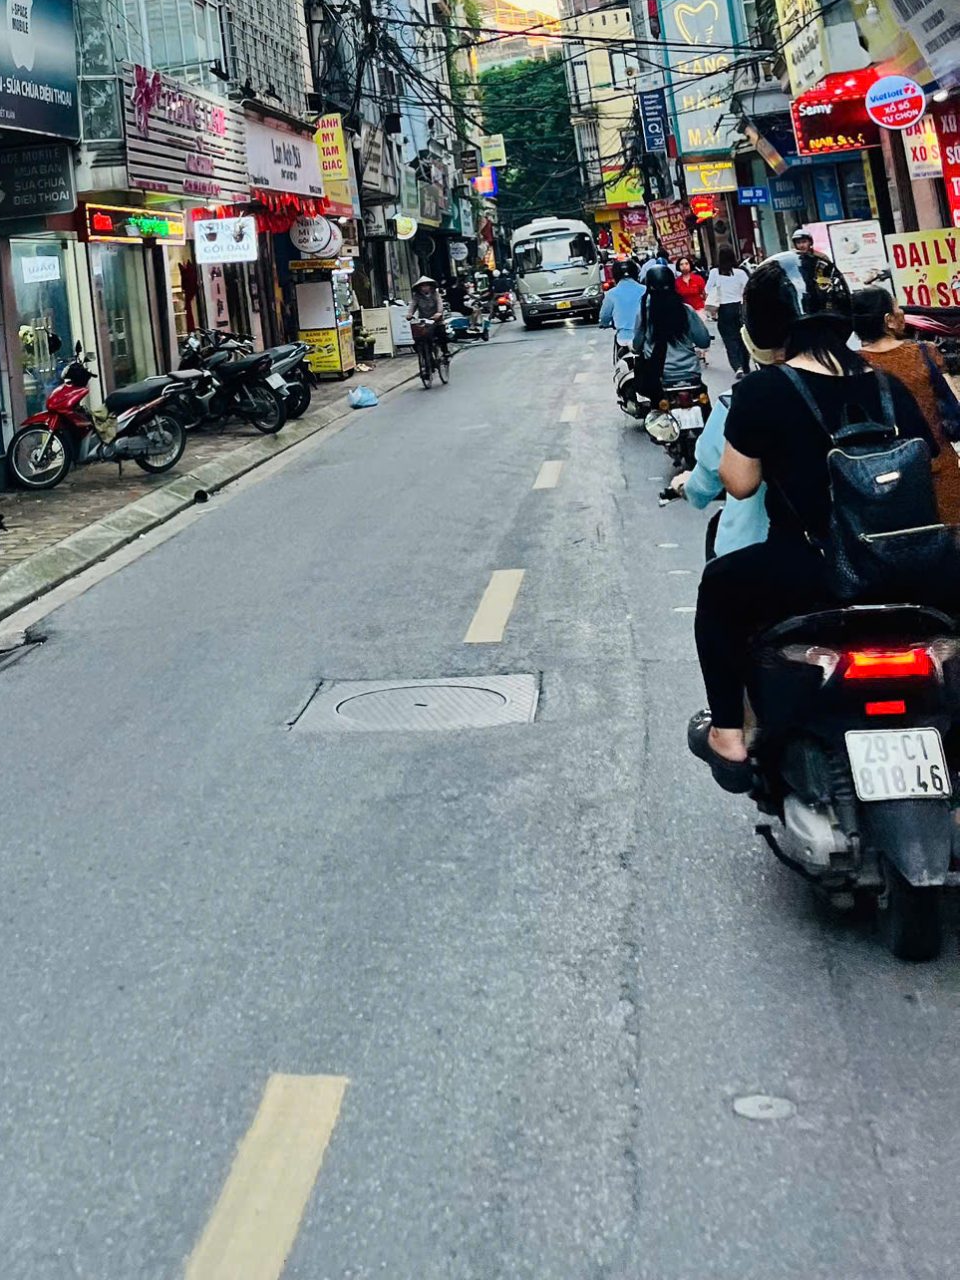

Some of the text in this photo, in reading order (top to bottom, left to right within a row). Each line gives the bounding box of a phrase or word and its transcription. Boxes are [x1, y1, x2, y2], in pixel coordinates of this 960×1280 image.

[870, 89, 903, 103] Vietlott
[892, 232, 957, 272] ĐẠI LÝ
[902, 274, 932, 307] XỔ
